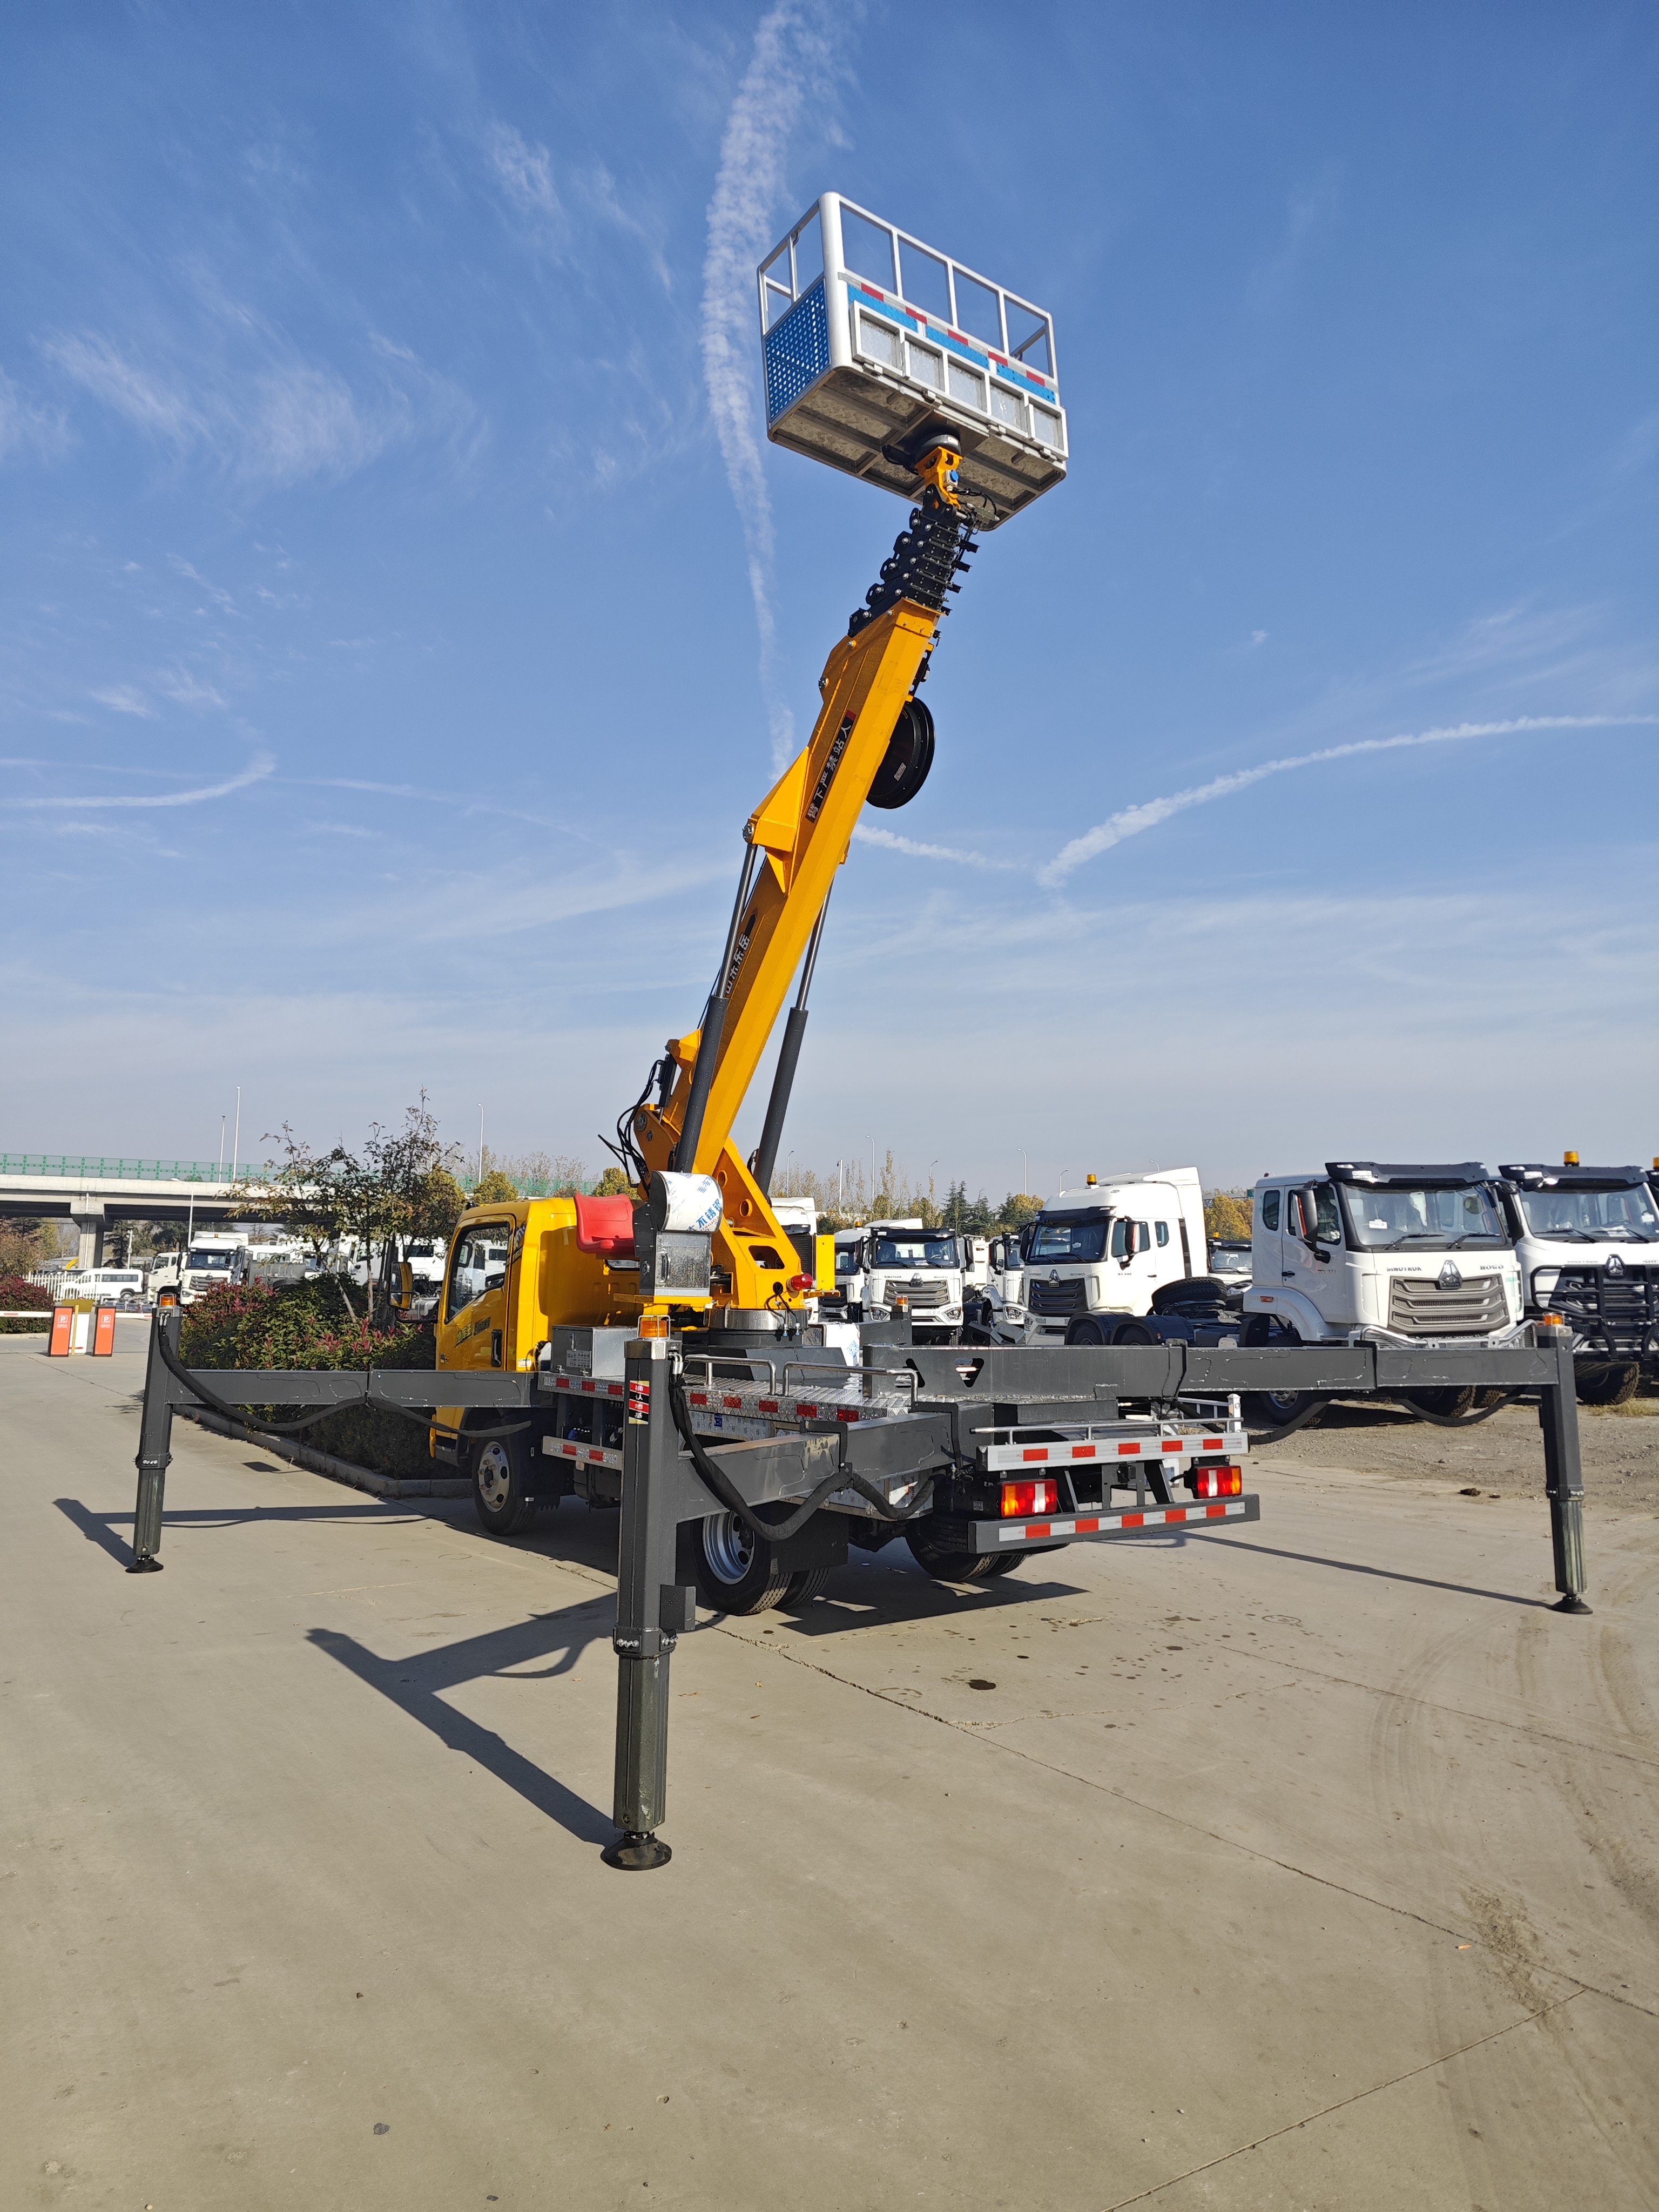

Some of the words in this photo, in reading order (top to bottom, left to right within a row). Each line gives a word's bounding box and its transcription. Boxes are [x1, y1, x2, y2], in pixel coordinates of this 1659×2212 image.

[807, 725, 851, 818] 臂下严禁站人
